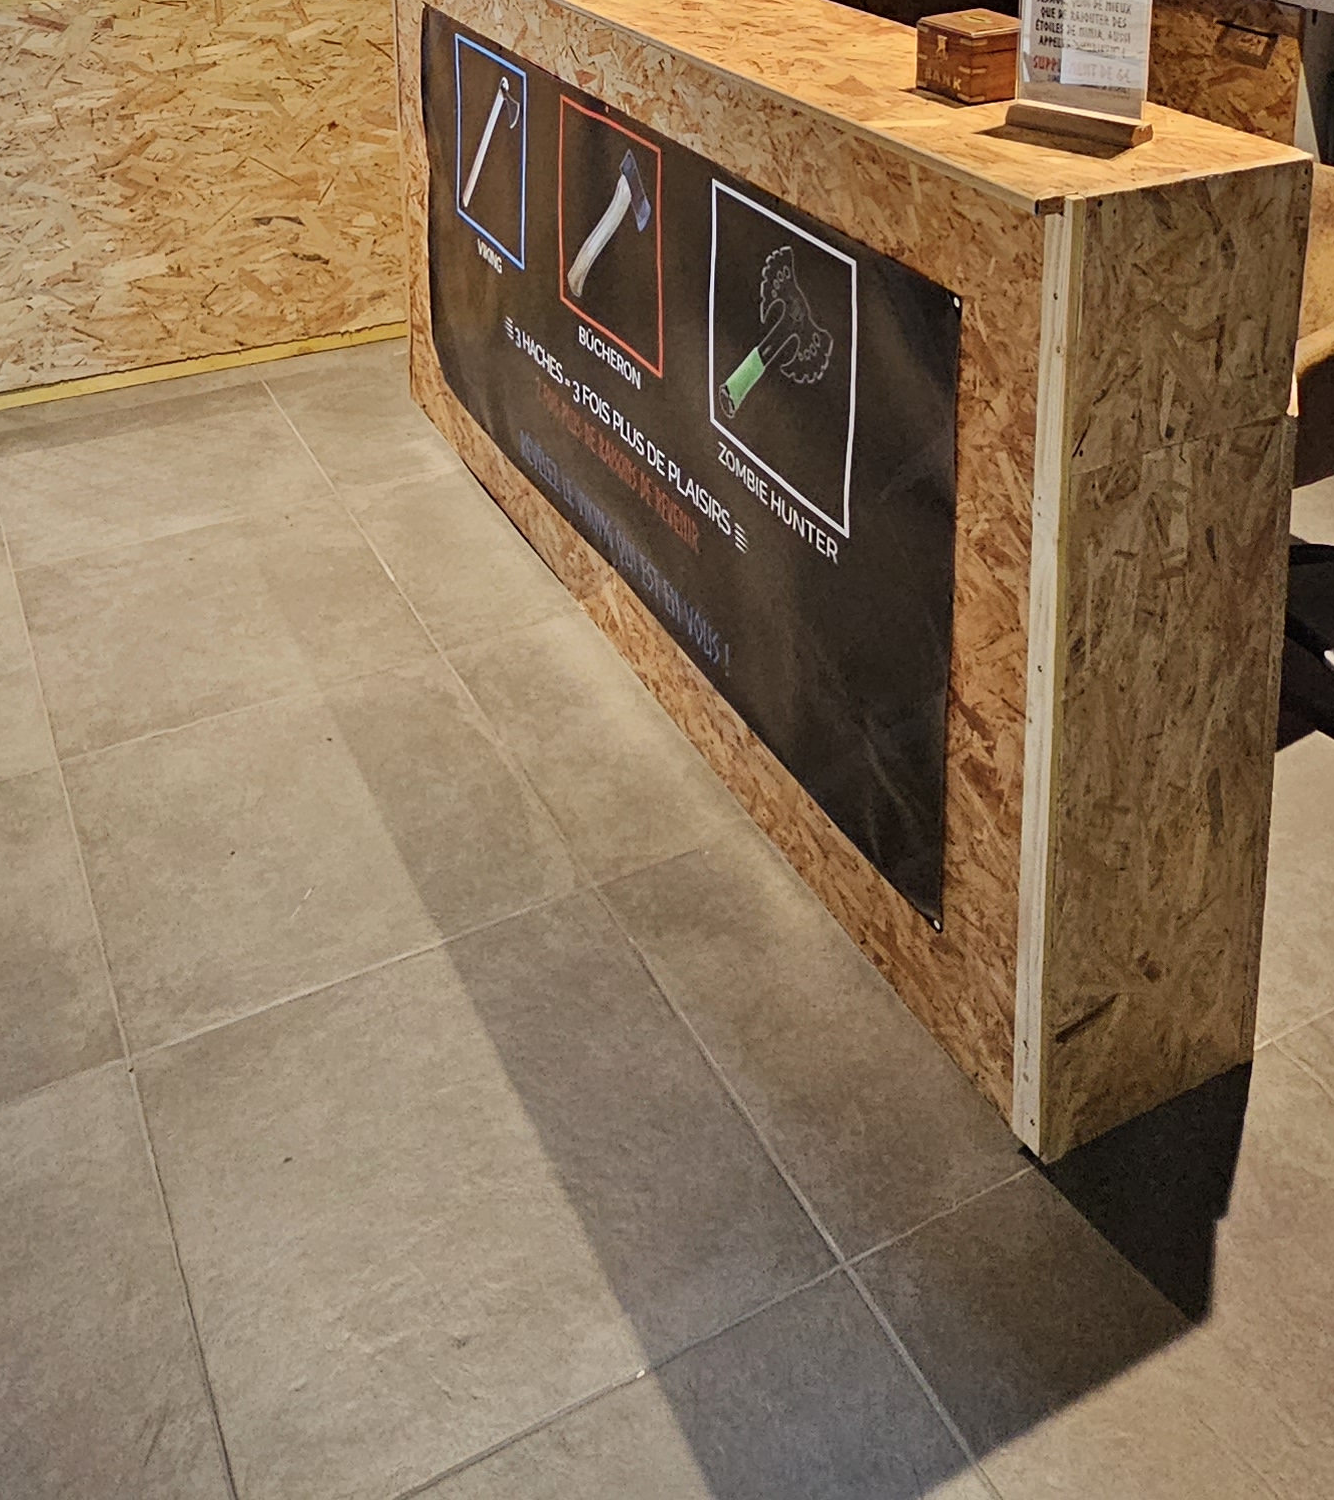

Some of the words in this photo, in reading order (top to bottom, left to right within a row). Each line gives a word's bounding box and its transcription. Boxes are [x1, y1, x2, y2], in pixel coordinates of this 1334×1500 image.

[923, 67, 962, 91] BANK
[476, 238, 503, 275] VIKING
[578, 324, 642, 391] BÛCHERON
[522, 332, 565, 385] HACHES
[572, 380, 581, 403] 3
[582, 384, 611, 425] FOIS
[612, 409, 645, 457] PLUS
[647, 439, 666, 477] DE
[668, 459, 732, 536] PLAISIRS
[717, 440, 768, 506] ZOMBIE
[770, 489, 840, 565] HUNTER
[684, 598, 720, 665] VOUS
